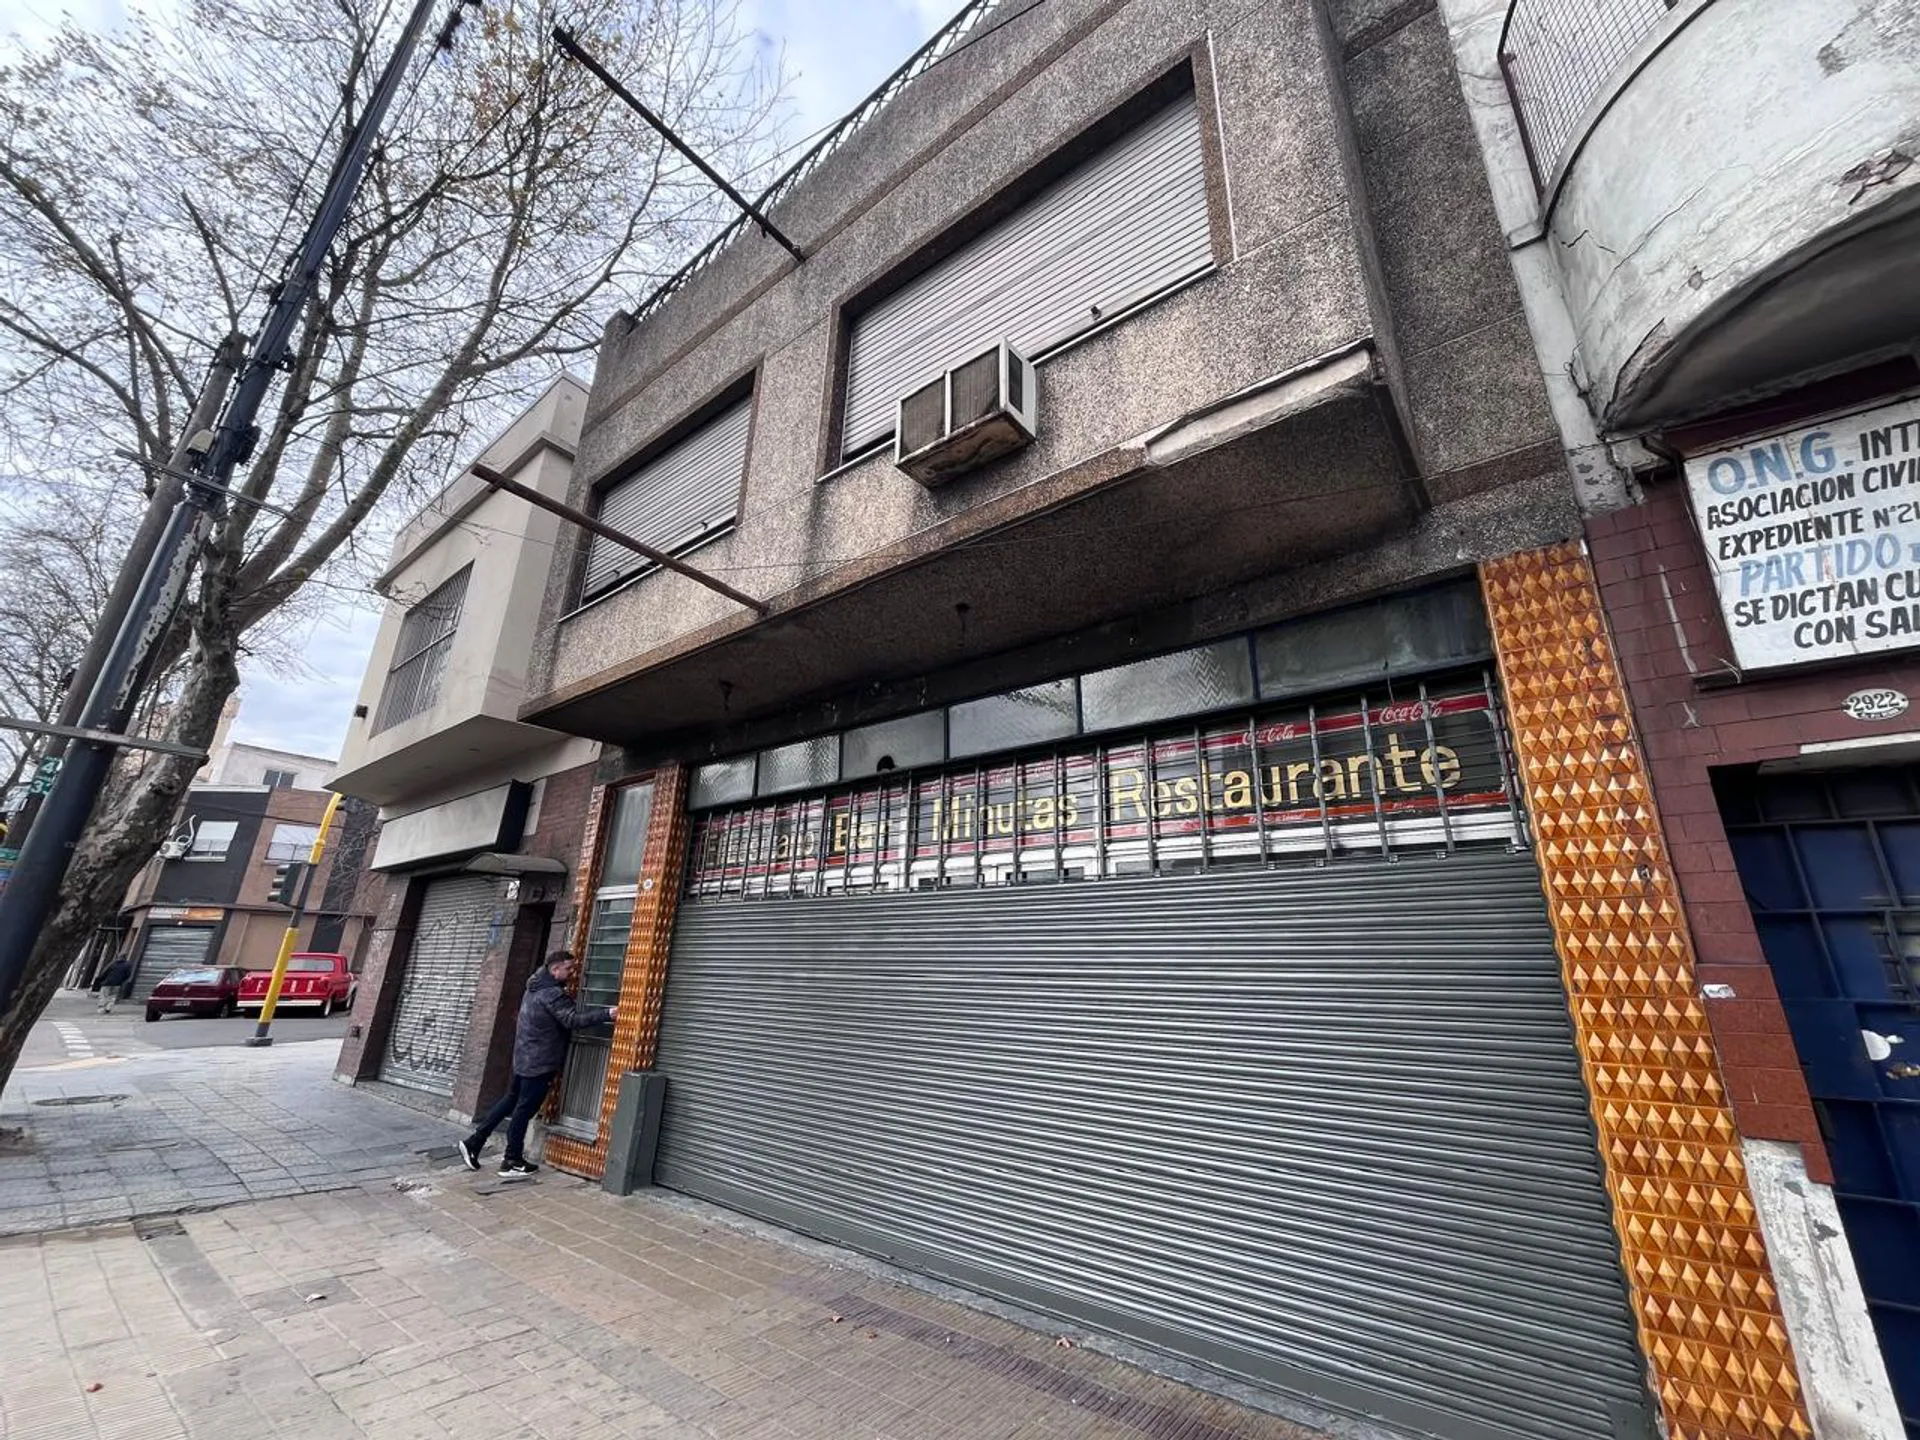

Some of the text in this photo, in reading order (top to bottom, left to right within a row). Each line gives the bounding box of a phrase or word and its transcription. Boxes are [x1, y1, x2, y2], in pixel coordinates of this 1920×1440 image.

[1707, 473, 1855, 530] ASOCIACION
[1719, 507, 1864, 560] EXPEDIENTE
[1739, 533, 1901, 597] PARTIDO
[1734, 598, 1767, 627] SE
[1770, 577, 1878, 621] DICTAN
[1794, 615, 1857, 649] CON
[1849, 691, 1900, 712] 2922
[931, 791, 1079, 841] Minutas
[1109, 732, 1462, 821] Restaurante
